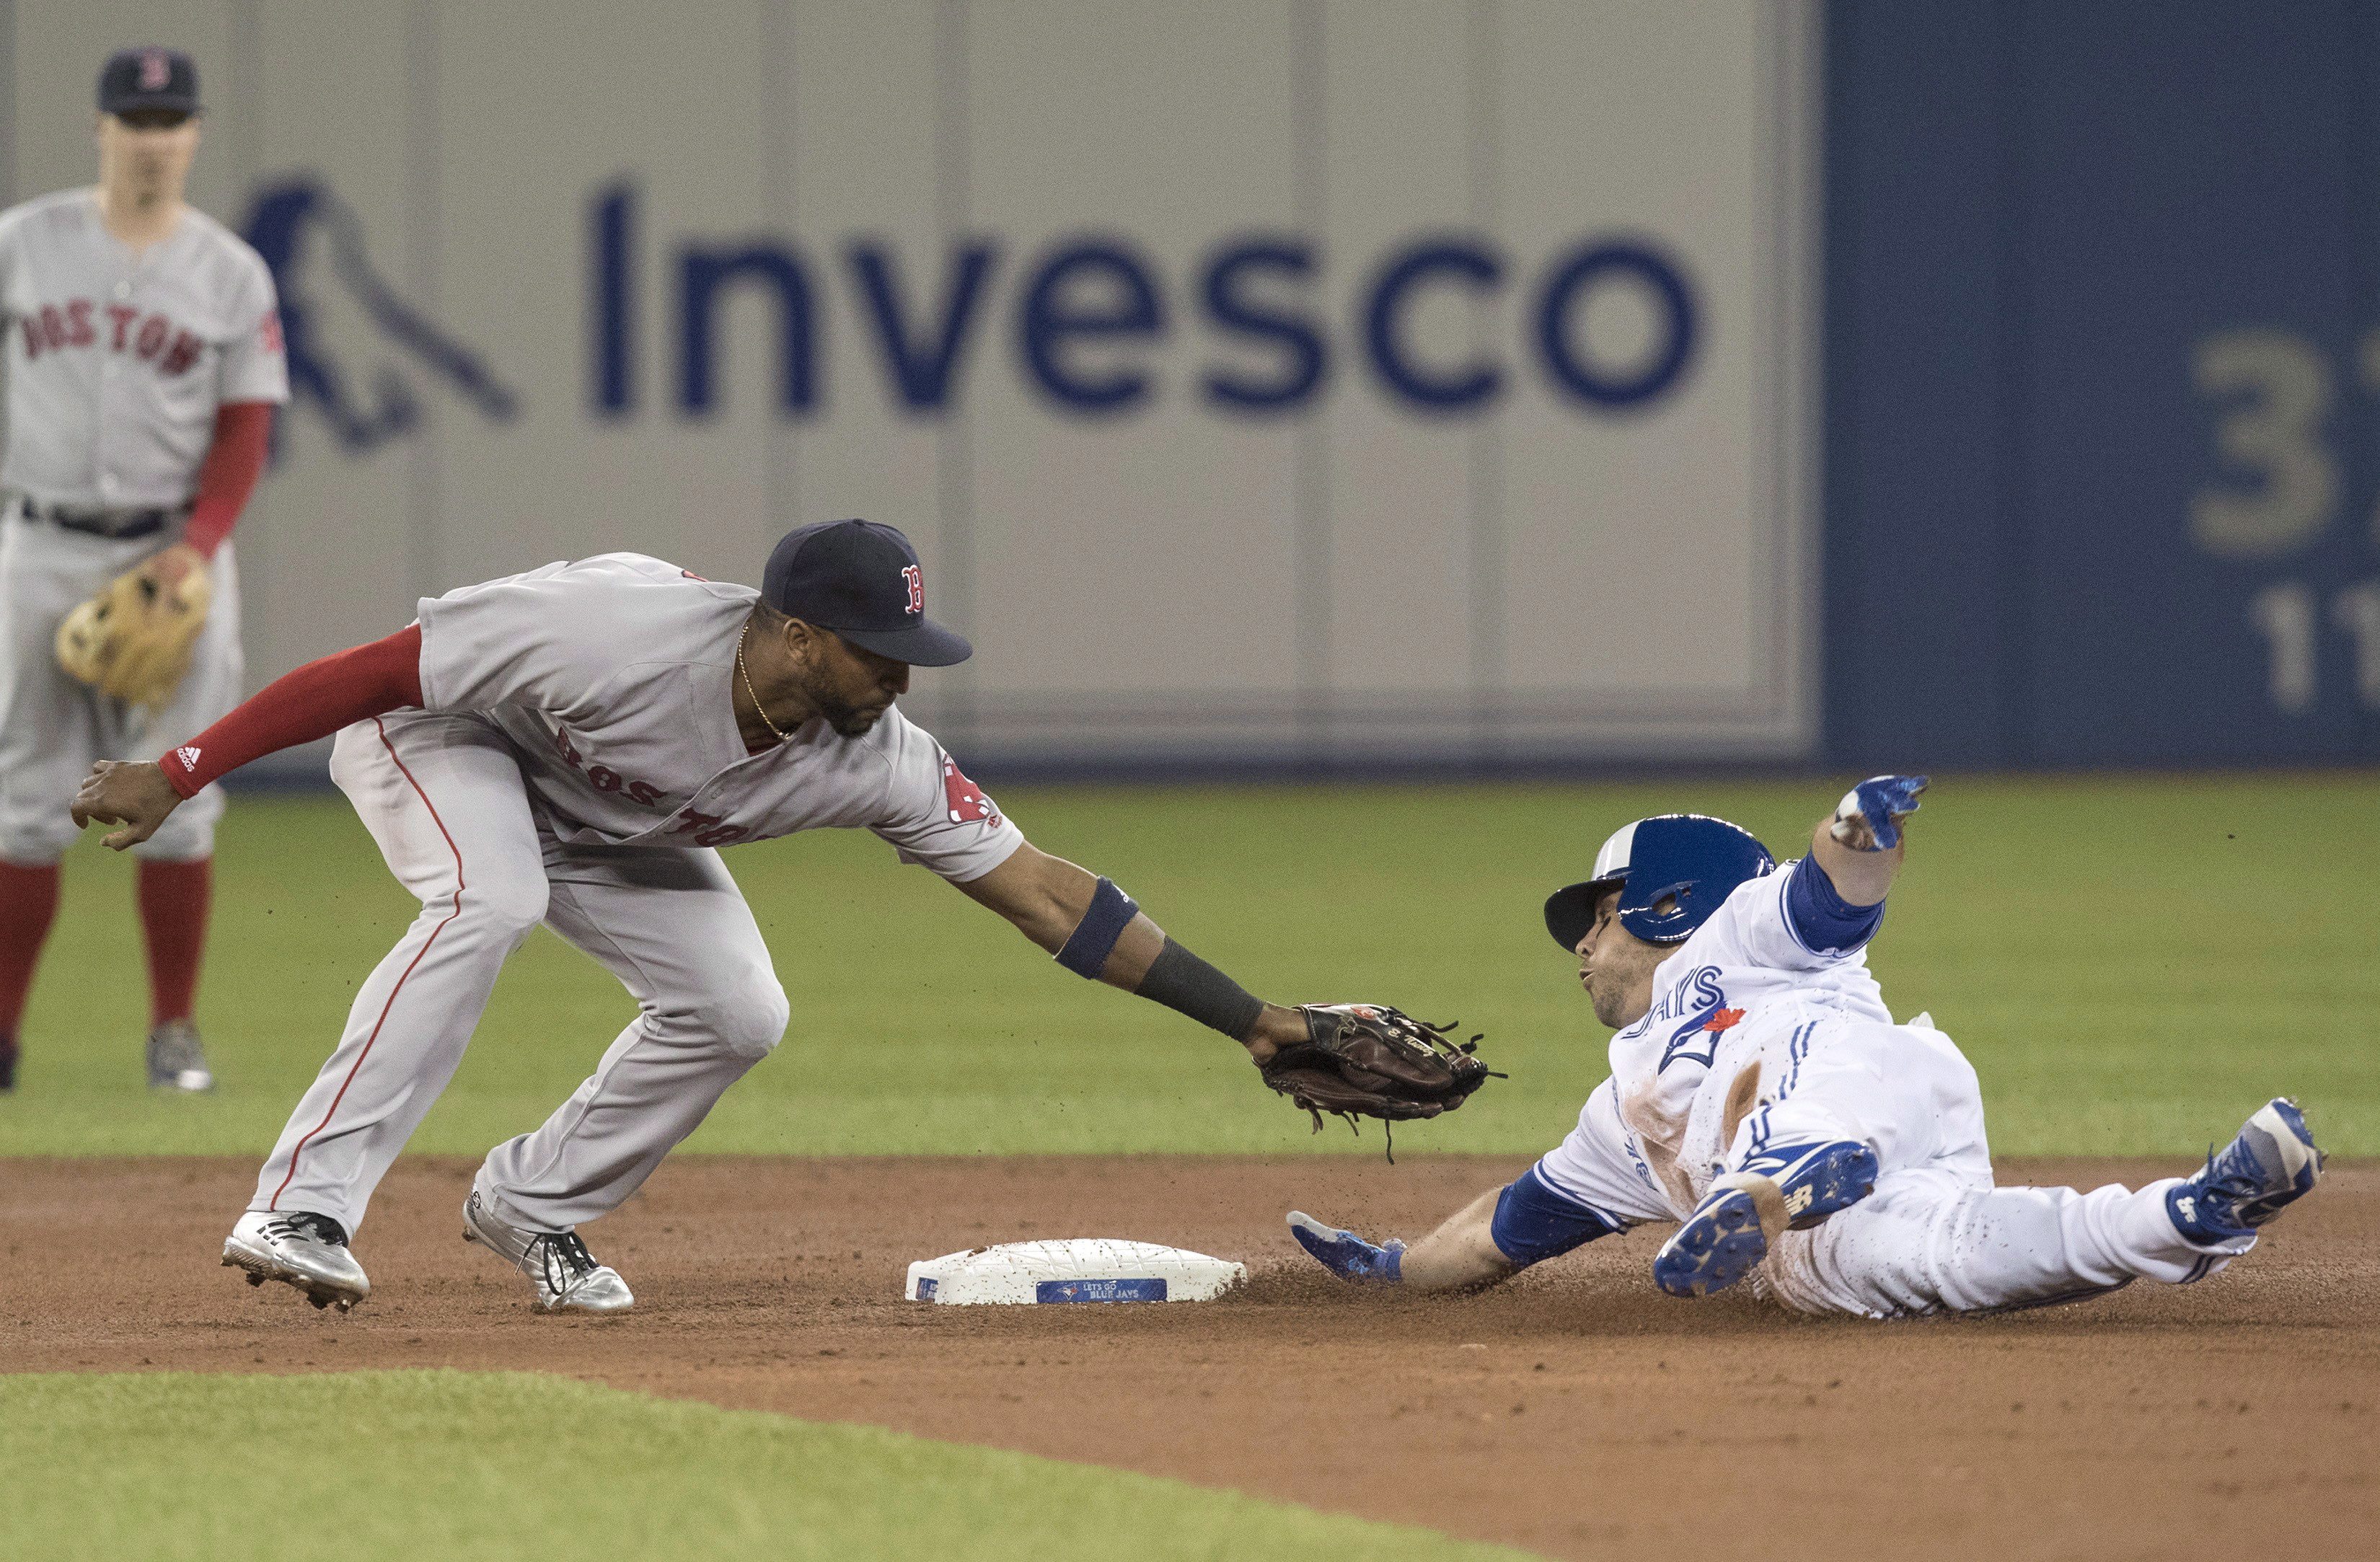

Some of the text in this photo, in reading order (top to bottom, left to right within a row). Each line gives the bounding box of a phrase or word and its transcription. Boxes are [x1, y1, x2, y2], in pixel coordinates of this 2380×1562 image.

[590, 179, 1700, 418] Invesco
[902, 564, 925, 614] B
[1620, 964, 1725, 1040] JAYS
[1090, 1289, 1139, 1299] BLUE JAYS
